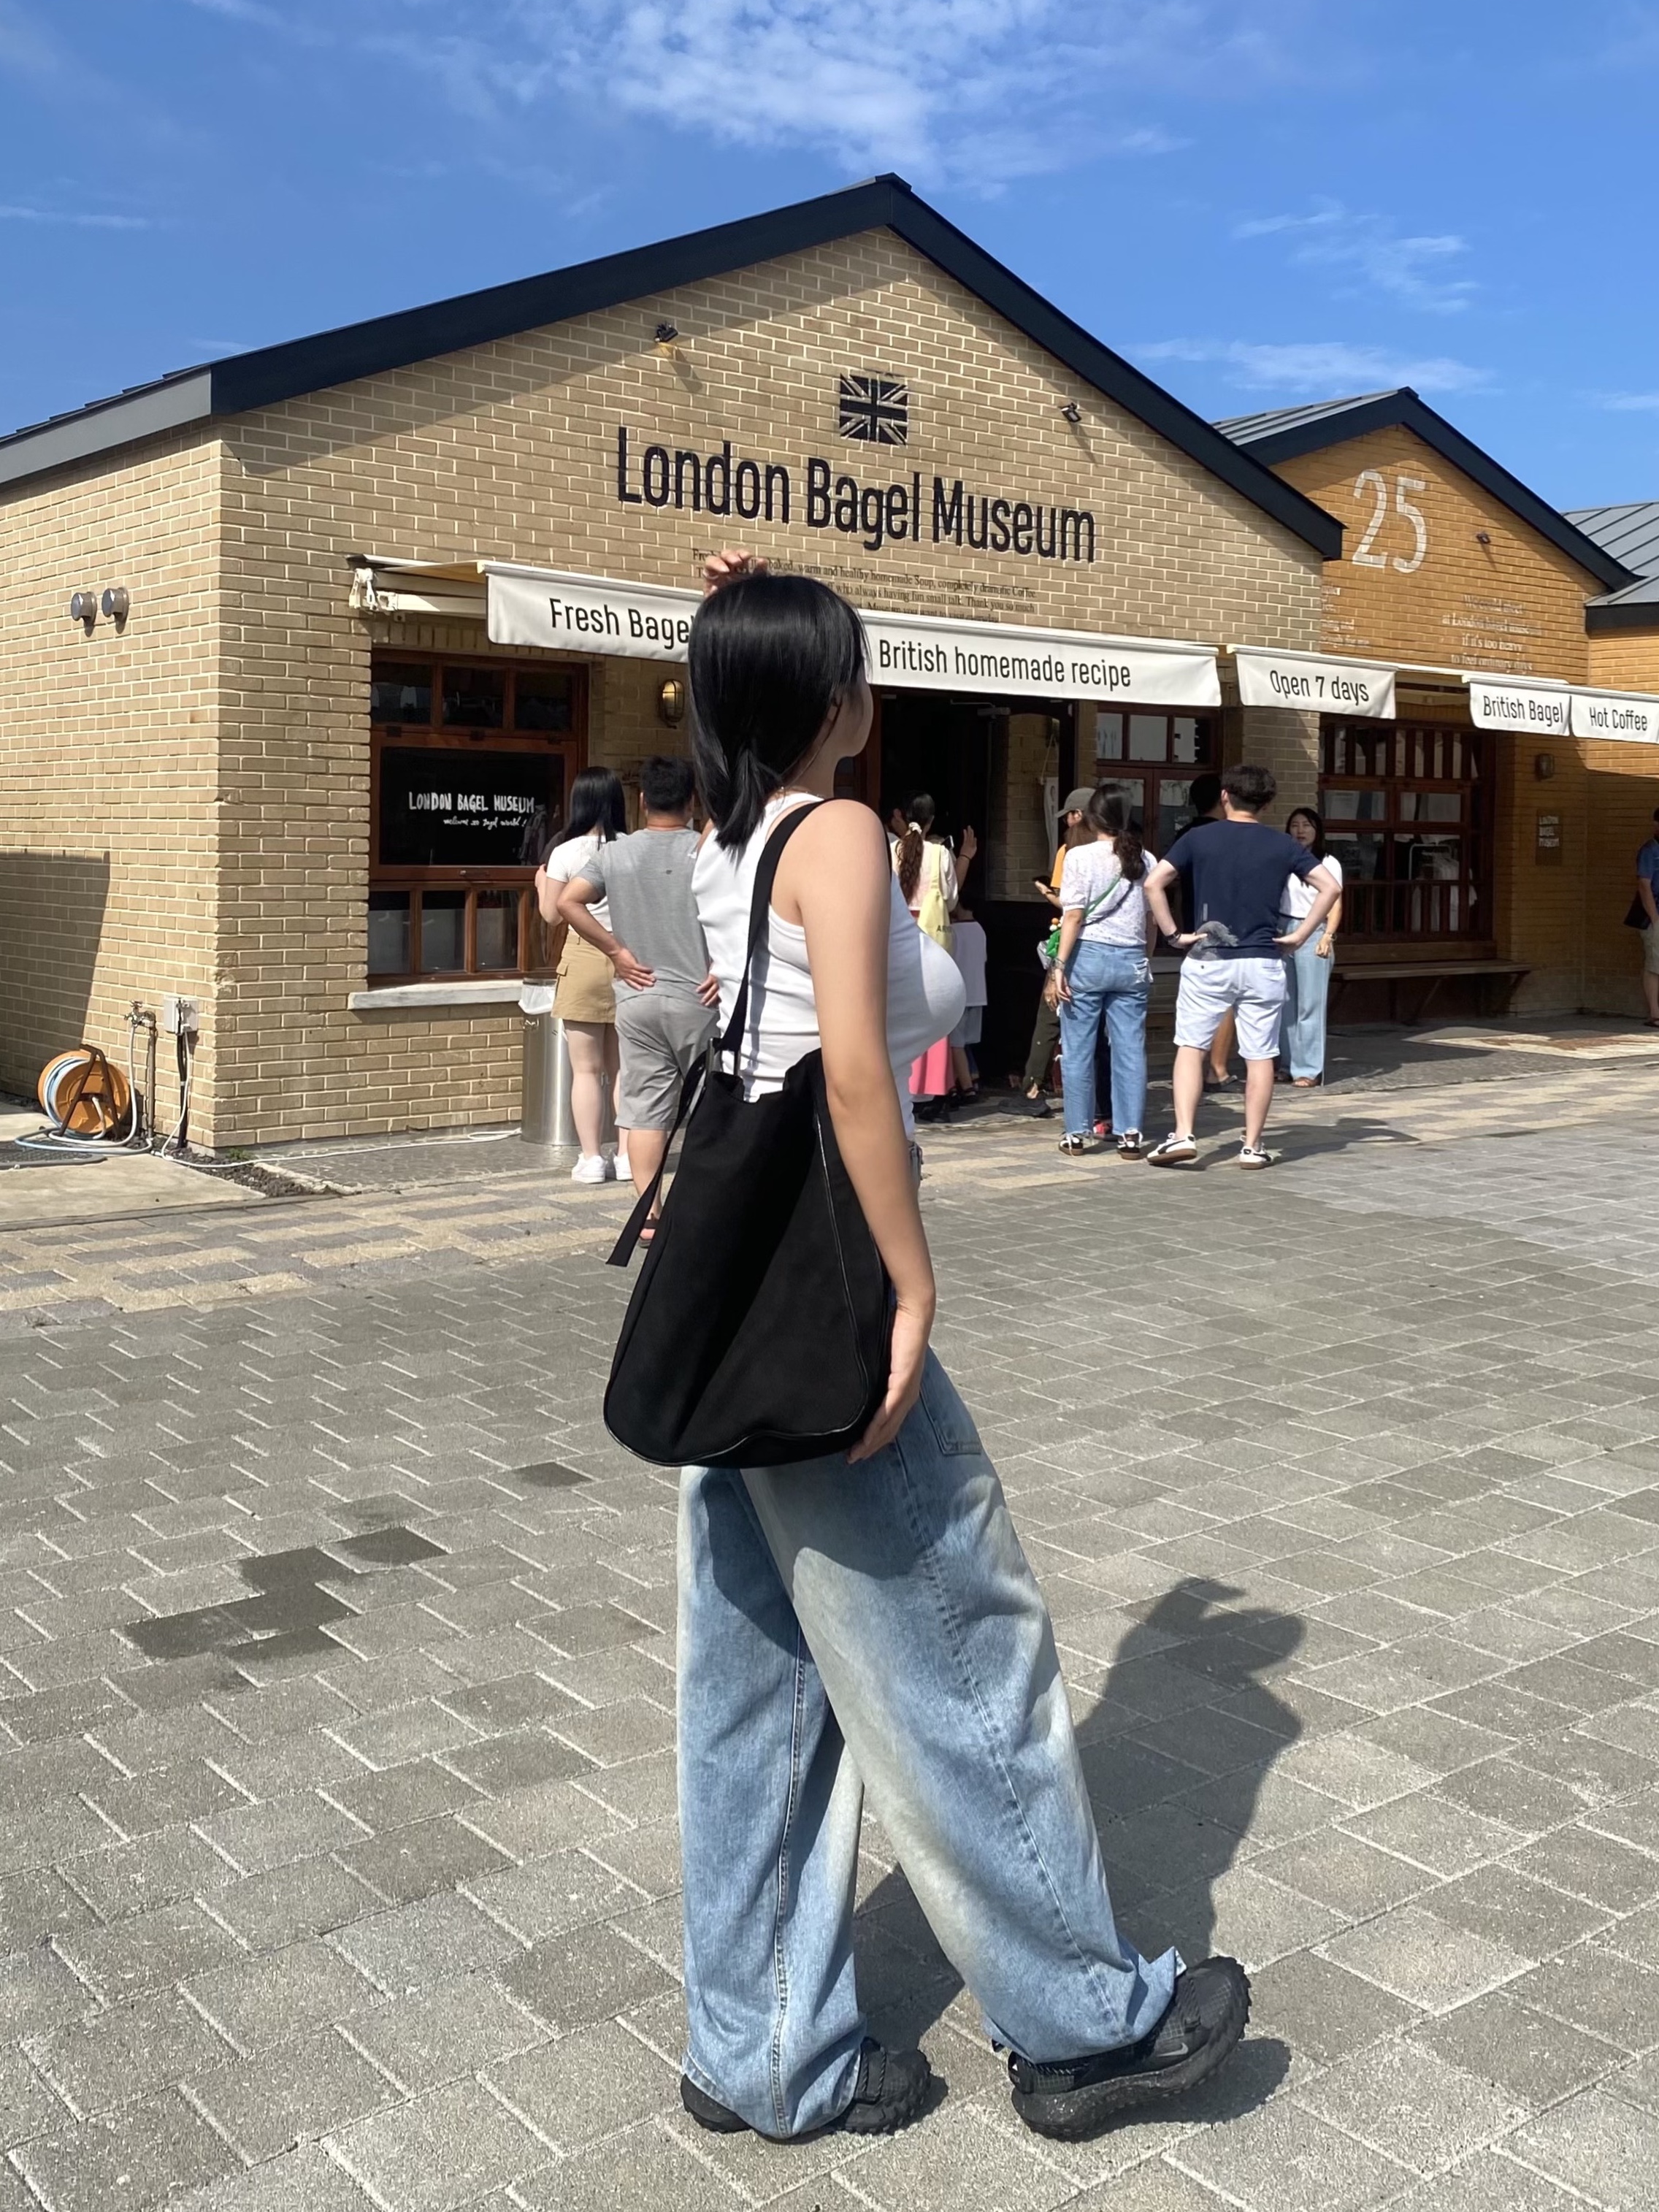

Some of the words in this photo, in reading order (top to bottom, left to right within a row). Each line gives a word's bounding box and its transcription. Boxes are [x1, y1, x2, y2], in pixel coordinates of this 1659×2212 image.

[618, 426, 789, 524] London
[807, 457, 920, 551] Bagel
[932, 477, 1095, 563] Museum
[1352, 469, 1427, 573] 25
[798, 563, 821, 575] warm
[824, 565, 838, 576] and
[840, 566, 869, 582] healthy
[870, 570, 912, 585] homemade
[914, 575, 936, 589] Soup,
[938, 579, 978, 595] completely
[980, 583, 1011, 596] dramatic
[836, 583, 853, 594] who
[855, 585, 882, 599] always
[884, 588, 910, 602] having
[912, 591, 924, 602] fun
[926, 594, 946, 605] small
[965, 596, 989, 608] Thank
[990, 600, 1004, 611] you
[1005, 602, 1014, 611] so
[1015, 602, 1035, 613] much
[549, 597, 620, 635] Fresh
[628, 608, 694, 650] Bage
[879, 639, 947, 673] British
[954, 646, 1065, 682] homemade
[1072, 659, 1131, 692] recipe
[1270, 670, 1311, 699] Open
[1315, 676, 1325, 697] 7
[1331, 676, 1369, 706] days
[1483, 695, 1525, 719] British
[1528, 700, 1563, 727] Bagel
[1589, 707, 1609, 727] Hot
[1612, 709, 1647, 731] Coffee
[409, 792, 452, 811] LONDON
[457, 793, 488, 813] BAGEL
[494, 795, 535, 814] MUSEUM
